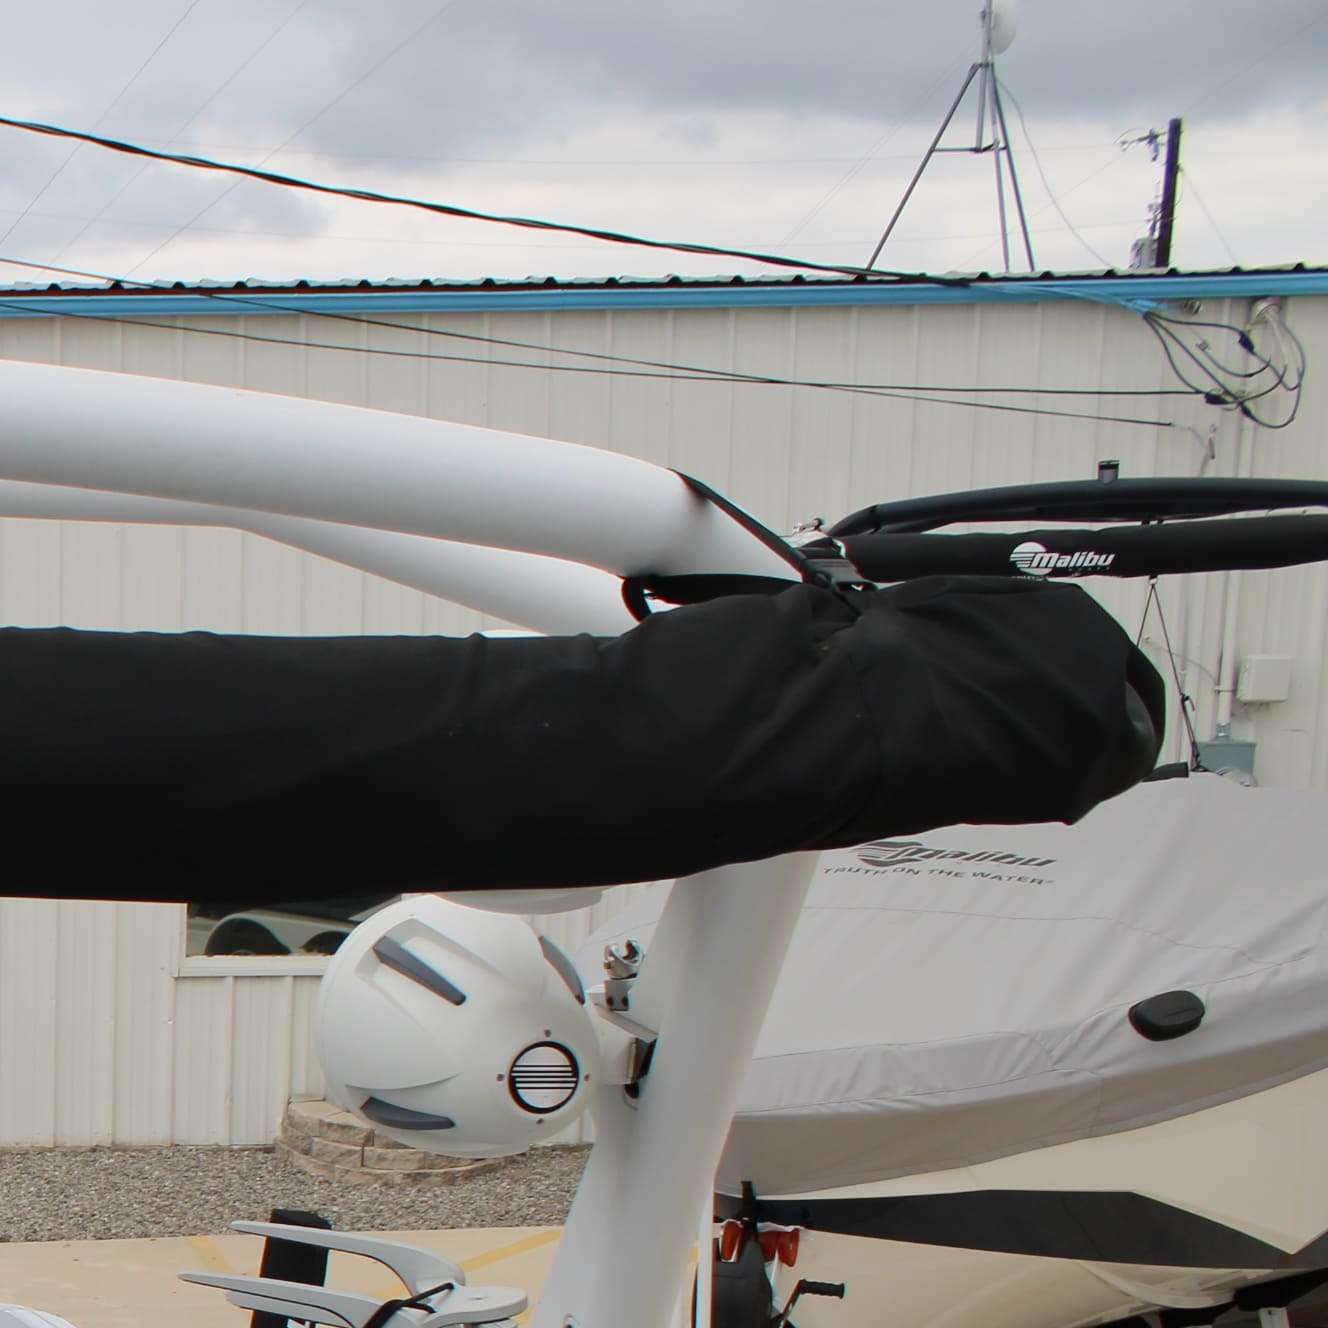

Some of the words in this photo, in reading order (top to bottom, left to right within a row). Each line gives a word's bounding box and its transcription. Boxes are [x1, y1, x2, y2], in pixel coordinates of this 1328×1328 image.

[824, 867, 887, 876] TRUTH
[892, 867, 921, 876] ON
[928, 869, 967, 879] THE
[972, 872, 1044, 886] WATER
